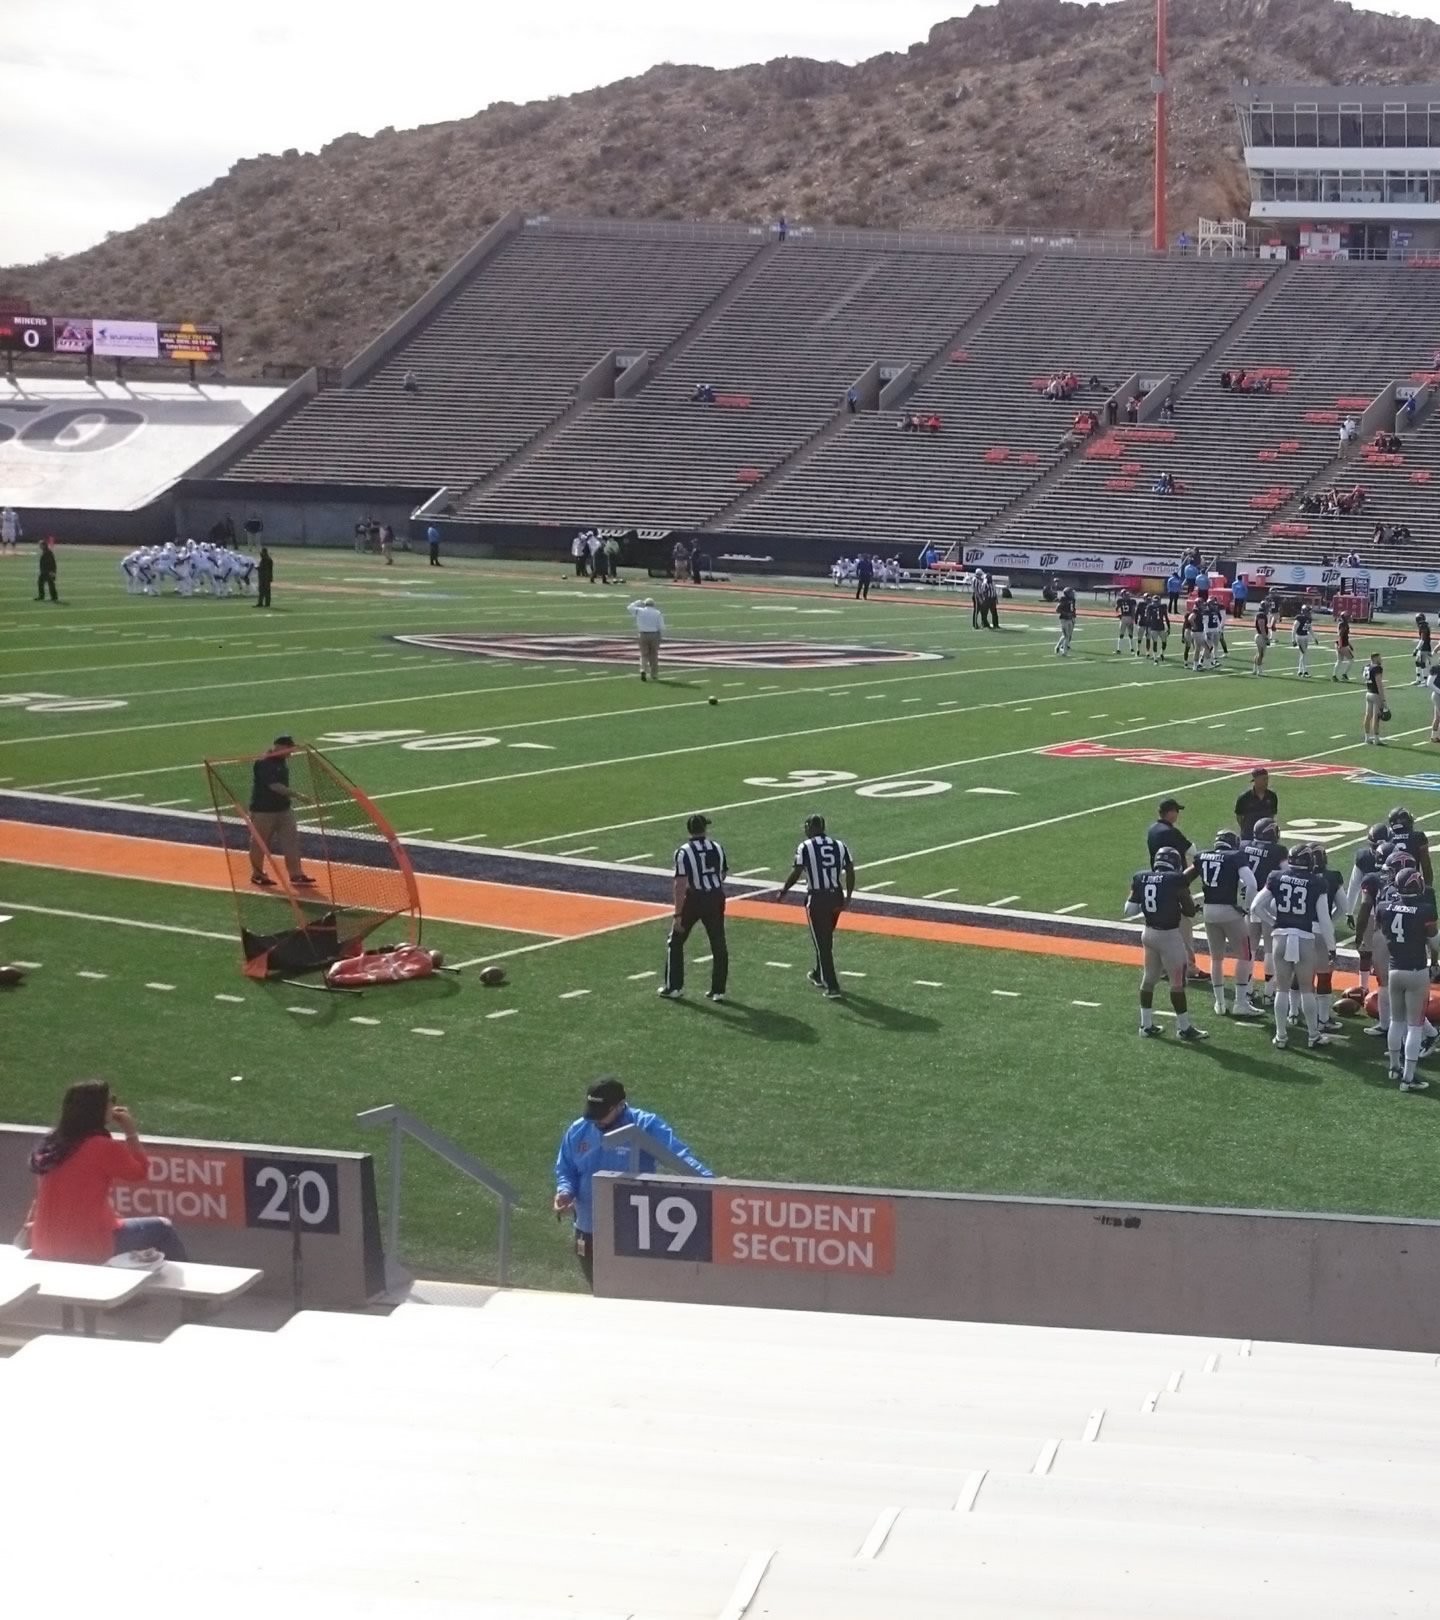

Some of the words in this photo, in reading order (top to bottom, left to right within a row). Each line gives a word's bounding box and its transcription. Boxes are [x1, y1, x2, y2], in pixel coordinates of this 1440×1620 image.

[14, 316, 48, 327] MINERS
[23, 329, 40, 348] 0
[1040, 552, 1059, 567] UTEP
[1114, 557, 1133, 571] UTEP
[1388, 572, 1407, 587] UTEP
[698, 852, 715, 874] L
[820, 845, 836, 867] S
[1248, 856, 1261, 874] 7
[1201, 861, 1221, 888] 17
[1144, 883, 1157, 913] 8
[1278, 883, 1308, 916] 33
[1390, 912, 1405, 943] 4
[148, 1156, 226, 1187] DENT
[255, 1166, 331, 1225] 20
[629, 1194, 698, 1252] 19
[730, 1198, 876, 1234] STUDENT
[731, 1233, 874, 1268] SECTION
